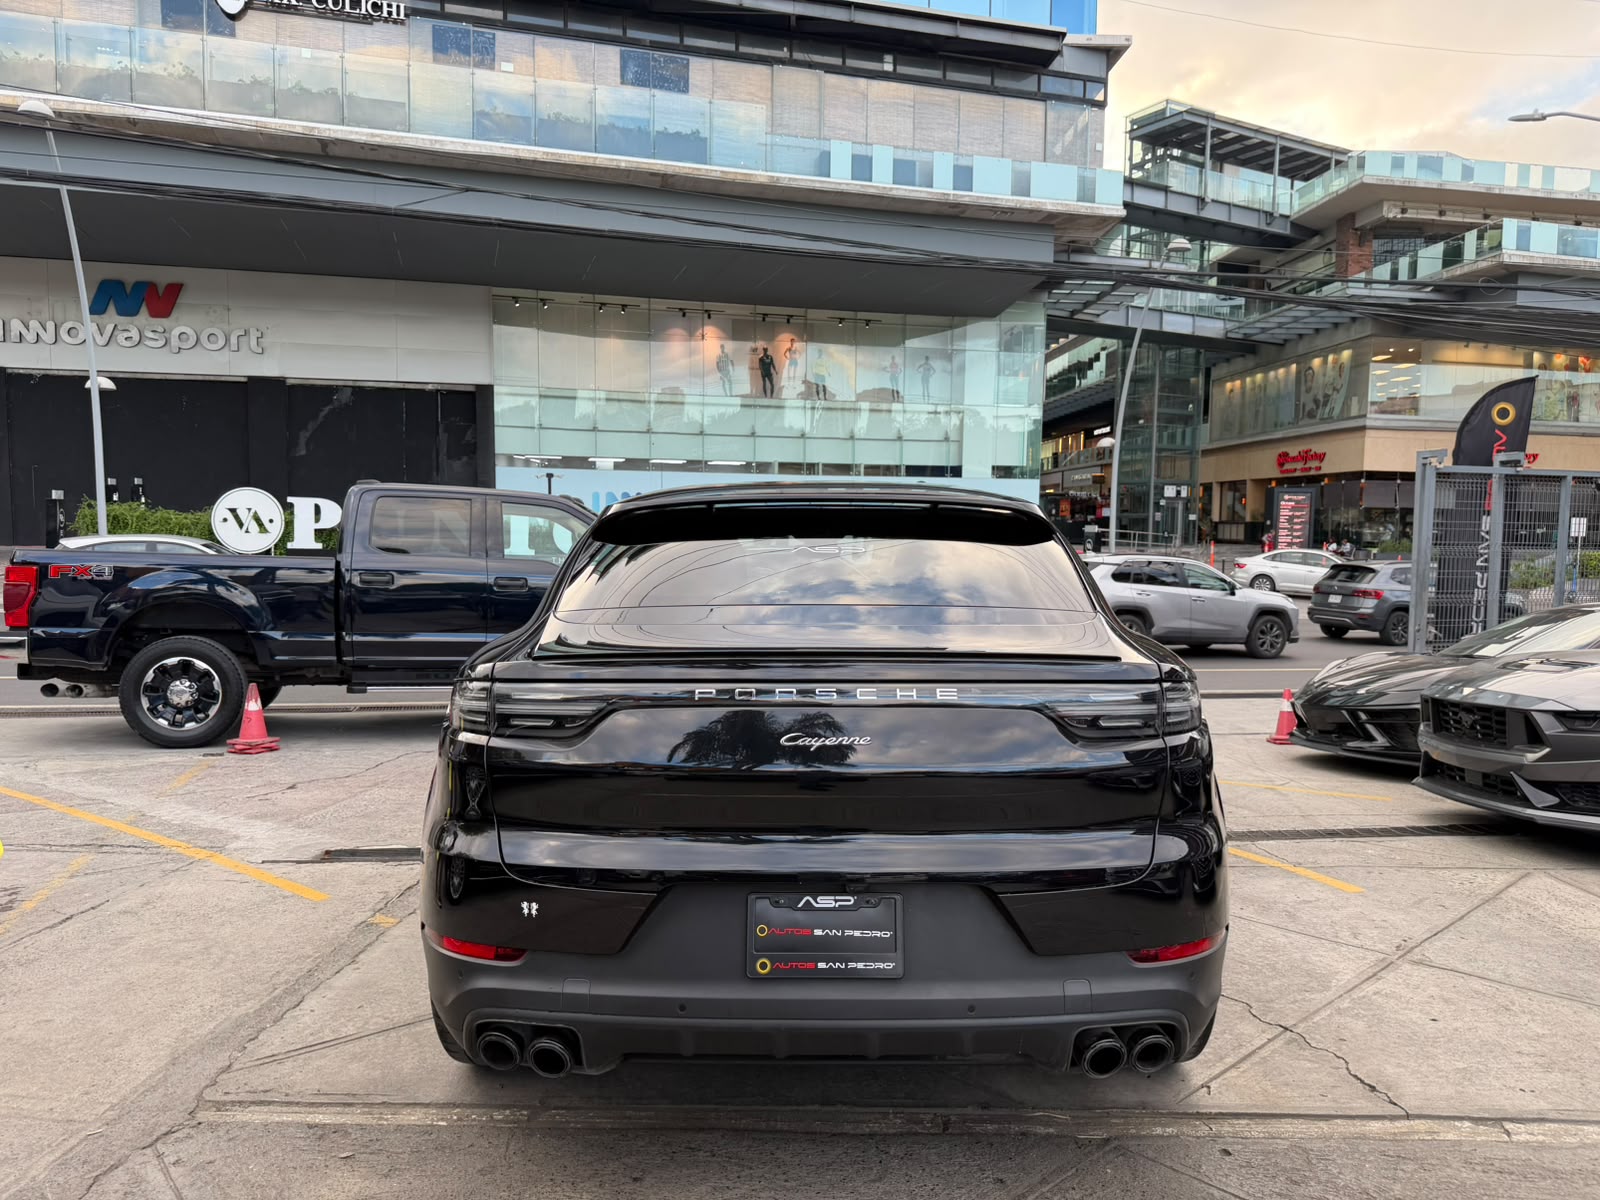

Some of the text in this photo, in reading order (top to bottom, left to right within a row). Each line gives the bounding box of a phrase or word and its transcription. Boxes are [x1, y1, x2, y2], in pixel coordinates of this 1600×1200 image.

[48, 564, 114, 579] FX4
[694, 688, 959, 701] PORSCHE
[779, 732, 873, 752] Cayenne
[797, 895, 855, 908] ASP
[768, 927, 813, 936] AUTOS
[813, 928, 842, 937] SAN
[772, 961, 816, 970] AUTOS
[817, 962, 846, 970] SAN
